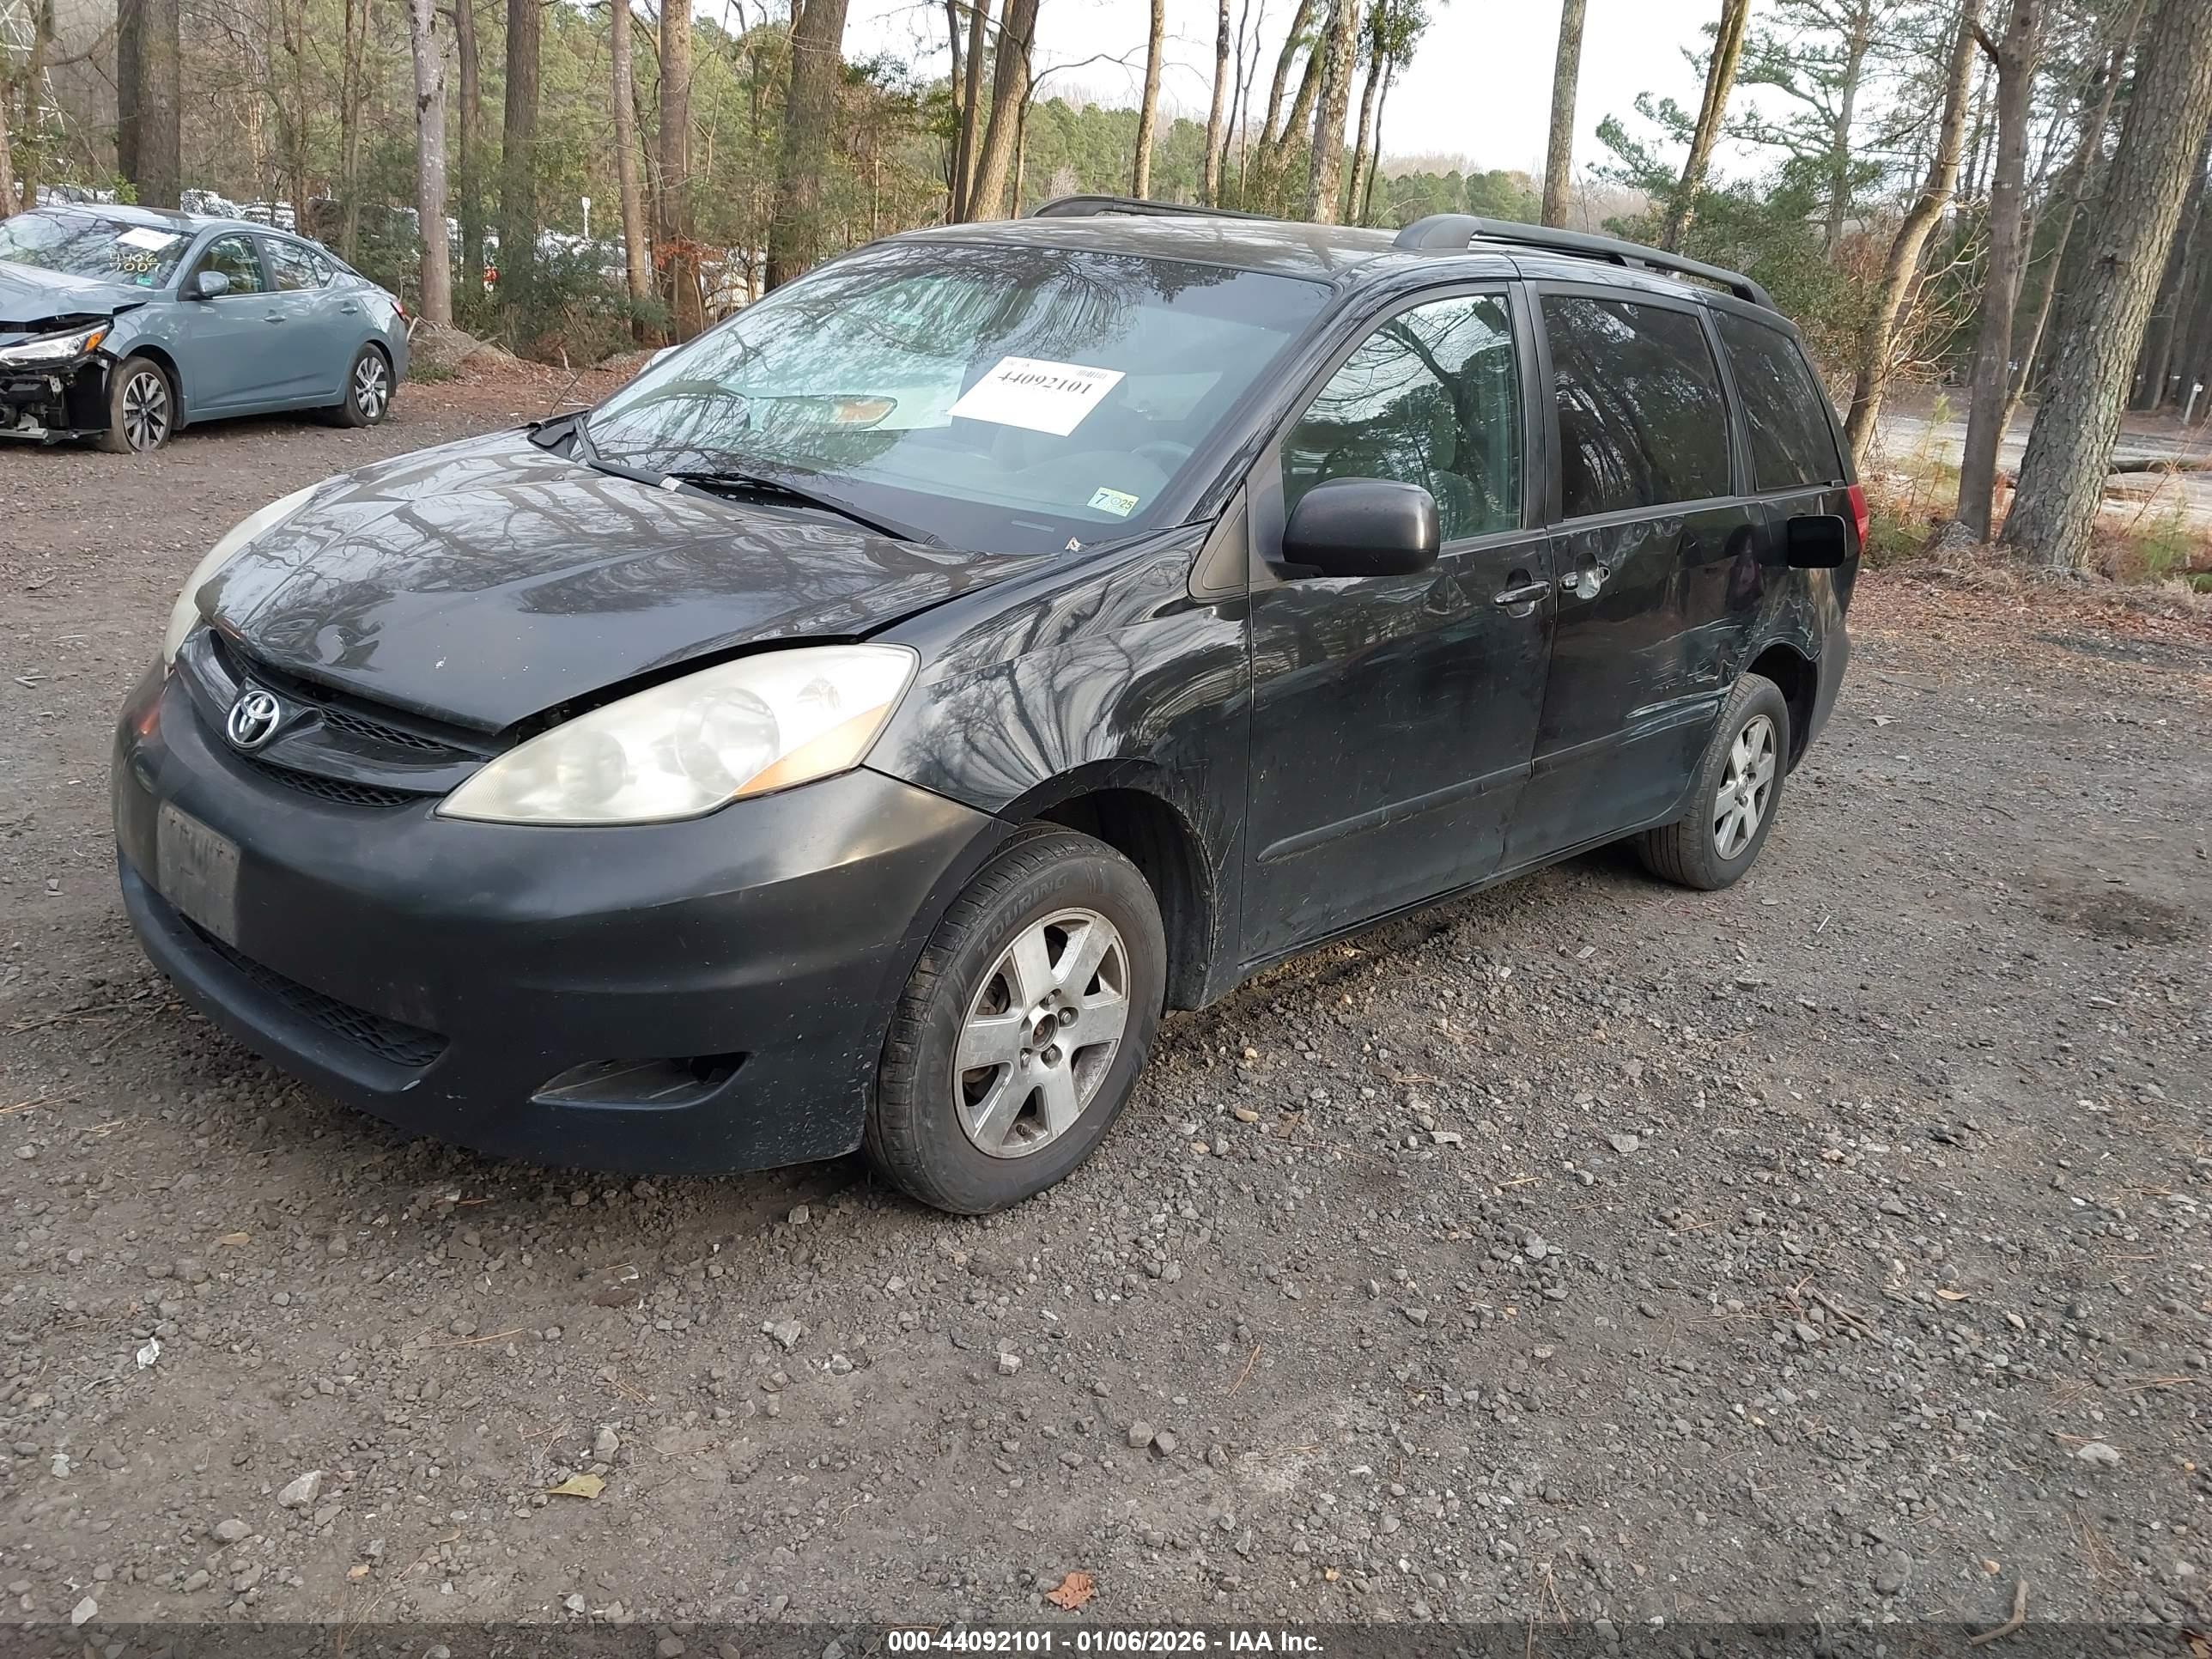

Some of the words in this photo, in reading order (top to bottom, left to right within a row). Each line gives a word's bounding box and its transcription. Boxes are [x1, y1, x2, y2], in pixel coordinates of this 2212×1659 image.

[109, 252, 158, 262] 4406
[109, 262, 161, 272] 7007
[997, 370, 1093, 394] 44092101
[1095, 493, 1109, 505] 7
[1119, 499, 1134, 510] 25
[977, 872, 1071, 957] TOURING
